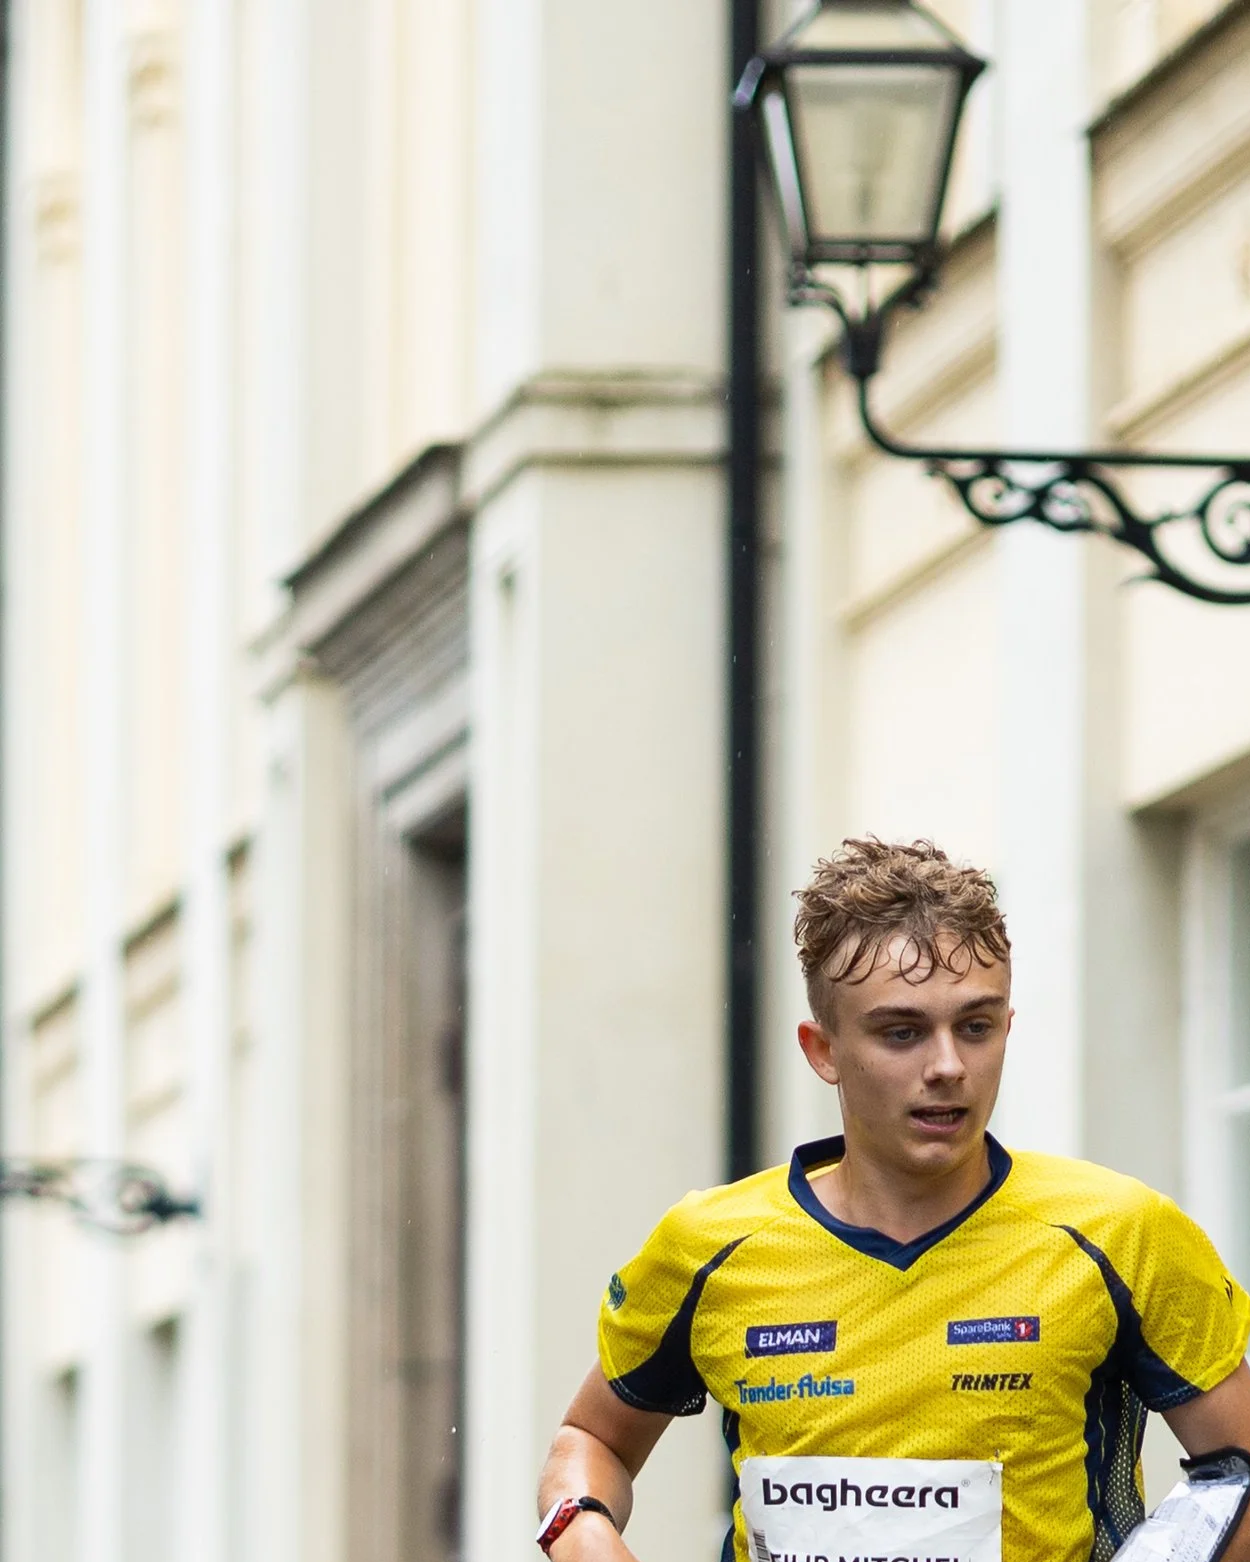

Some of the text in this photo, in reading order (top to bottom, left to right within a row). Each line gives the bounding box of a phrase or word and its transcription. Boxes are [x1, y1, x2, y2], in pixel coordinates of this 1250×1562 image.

[953, 1321, 1011, 1335] SpareBank
[758, 1328, 820, 1348] ELMAN
[951, 1372, 1033, 1391] TRIMTEX
[762, 1478, 959, 1511] bagheera
